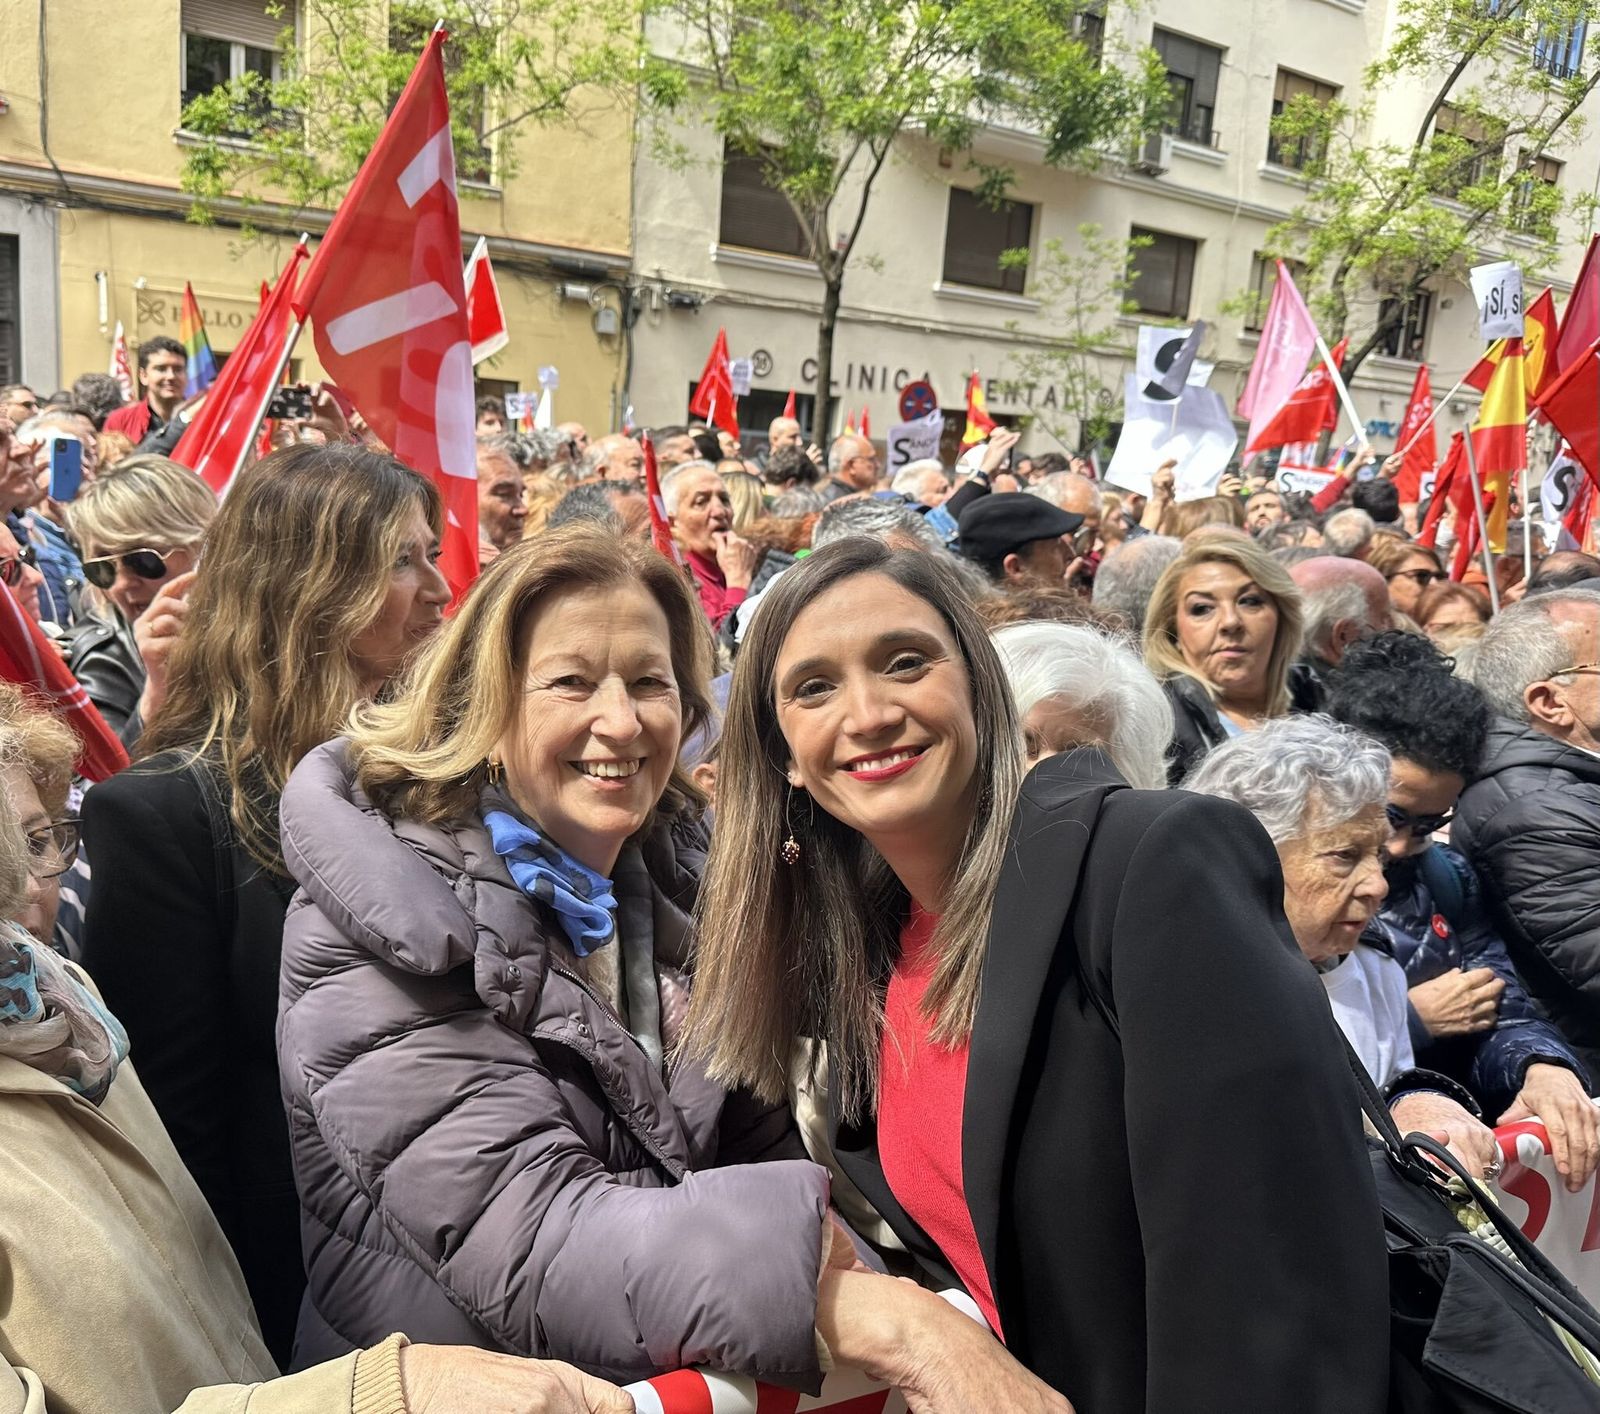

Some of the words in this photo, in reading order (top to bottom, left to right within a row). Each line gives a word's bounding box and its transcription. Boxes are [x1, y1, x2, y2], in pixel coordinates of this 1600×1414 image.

[172, 305, 243, 328] HLLO
[801, 357, 932, 391] CINIC
[966, 377, 1080, 411] ENTAL
